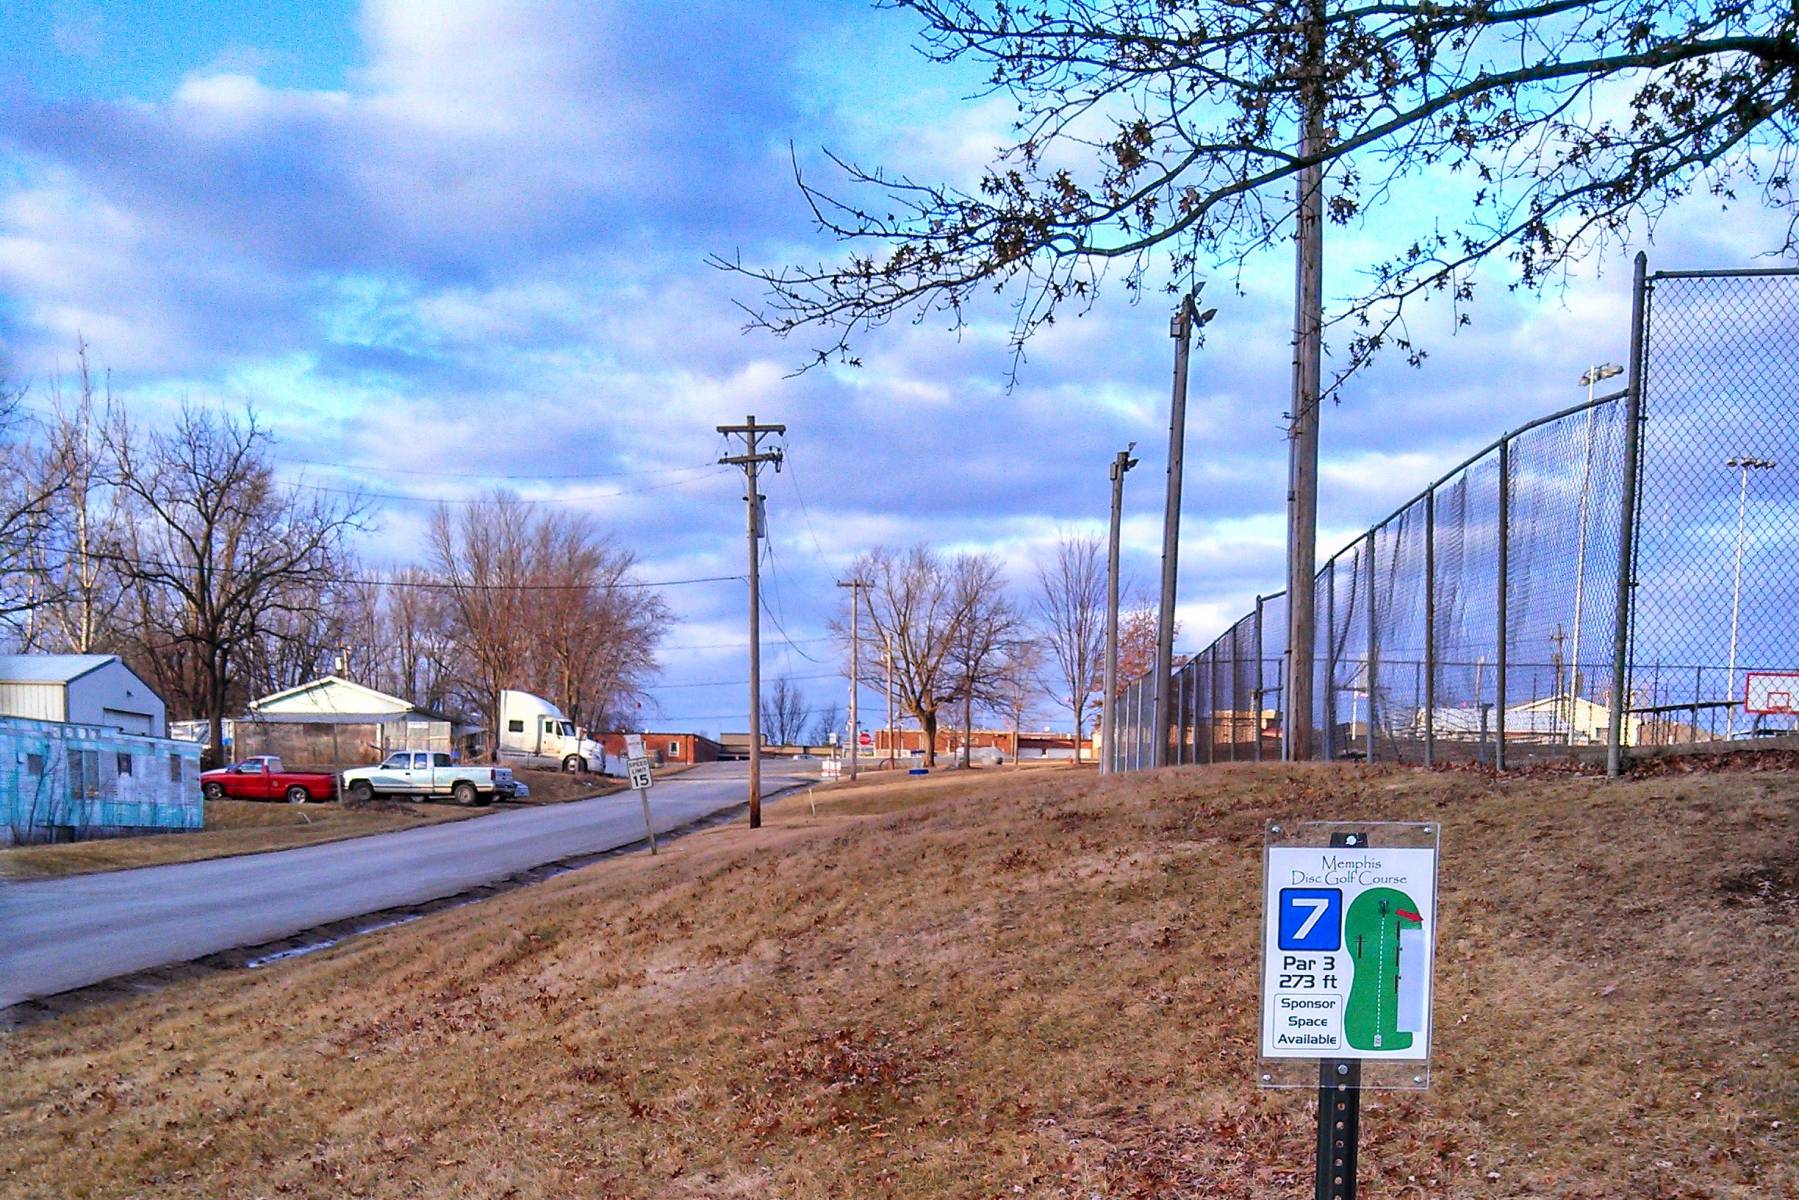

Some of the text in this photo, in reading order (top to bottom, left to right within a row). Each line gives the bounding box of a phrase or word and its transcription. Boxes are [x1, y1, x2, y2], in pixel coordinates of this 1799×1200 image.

[633, 774, 649, 787] 15
[1321, 855, 1382, 874] Memphis
[1291, 870, 1408, 886] Disc Golf Course
[1291, 898, 1329, 940] 7
[1283, 956, 1335, 971] Par 3
[1279, 974, 1338, 989] 273 ft
[1280, 998, 1336, 1011] Sponsor
[1288, 1015, 1328, 1029] Space
[1277, 1033, 1337, 1045] Available
